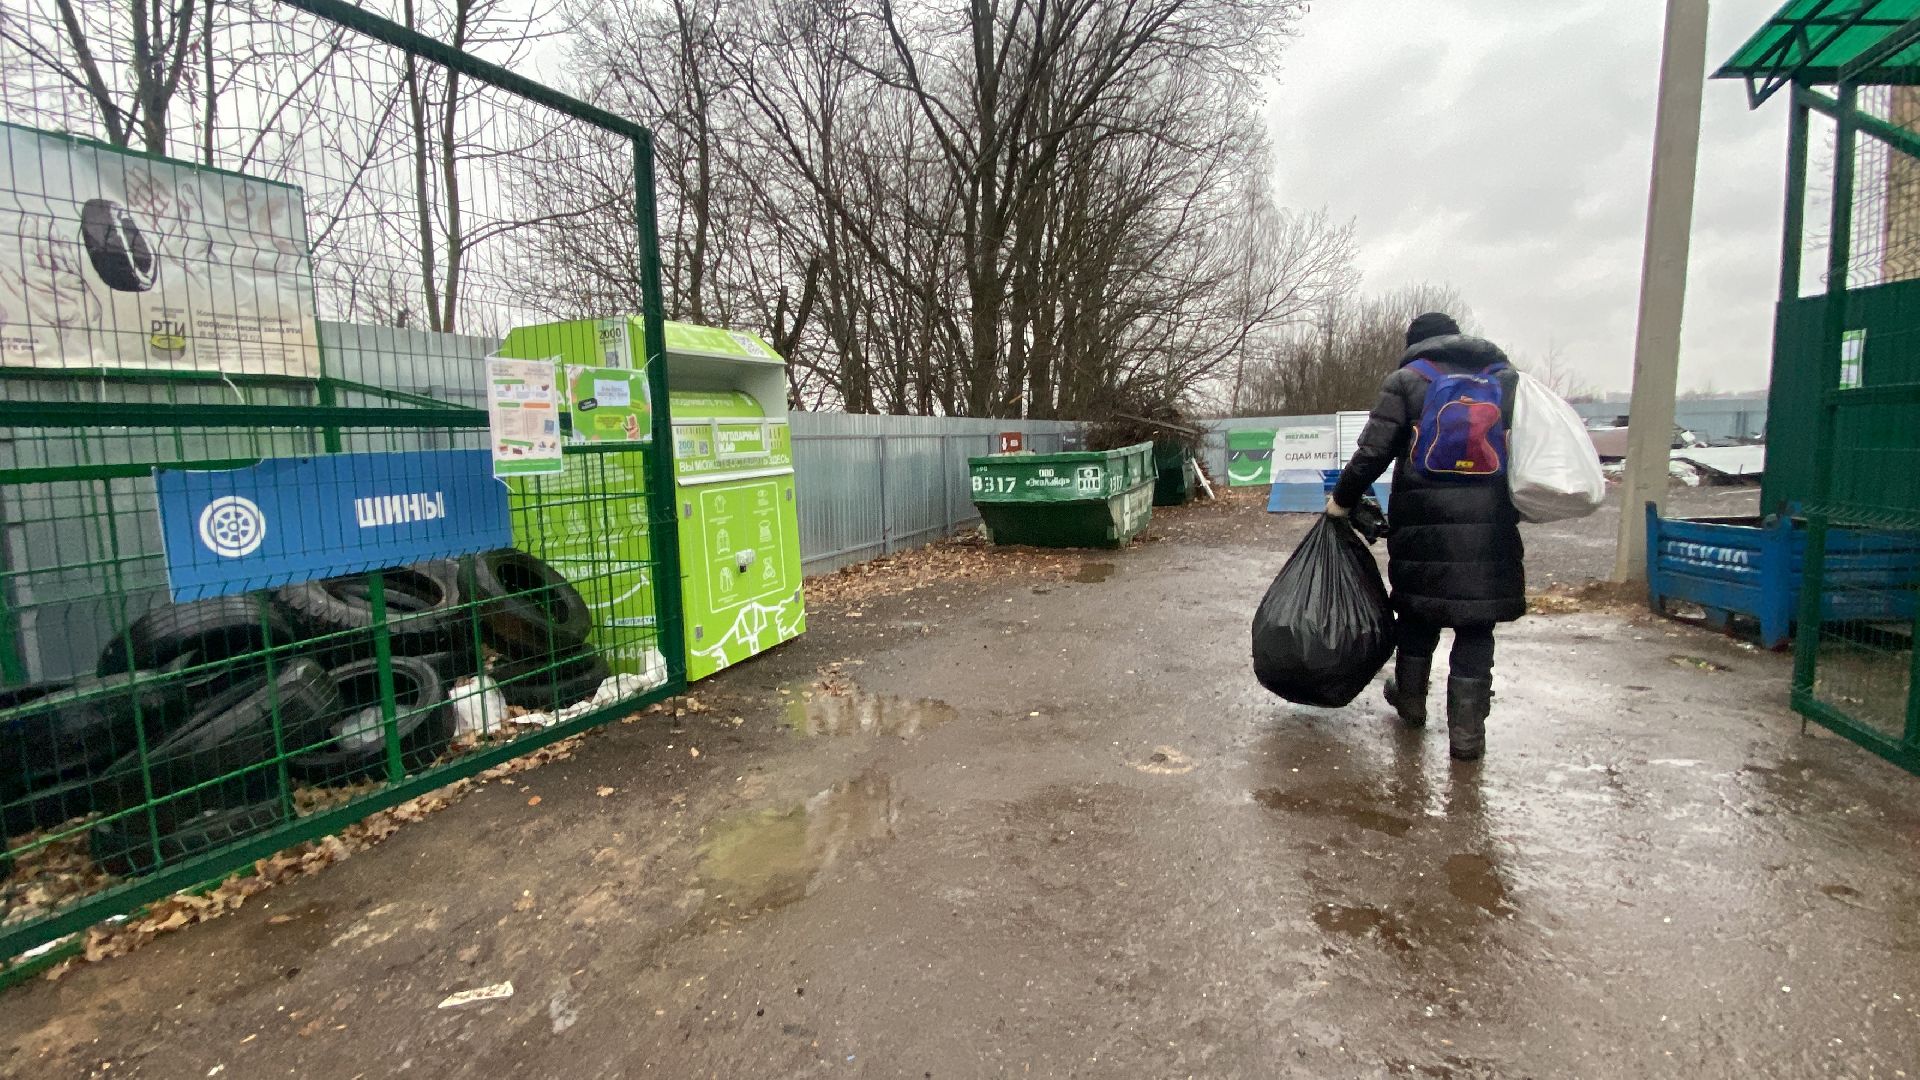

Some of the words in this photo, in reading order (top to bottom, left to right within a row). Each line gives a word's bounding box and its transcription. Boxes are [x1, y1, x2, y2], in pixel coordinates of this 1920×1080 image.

[151, 319, 186, 337] РТИ
[599, 327, 622, 340] 2000
[1285, 452, 1312, 462] СДАЙ
[1038, 468, 1055, 478] ООО
[354, 491, 446, 528] ШИНЫ
